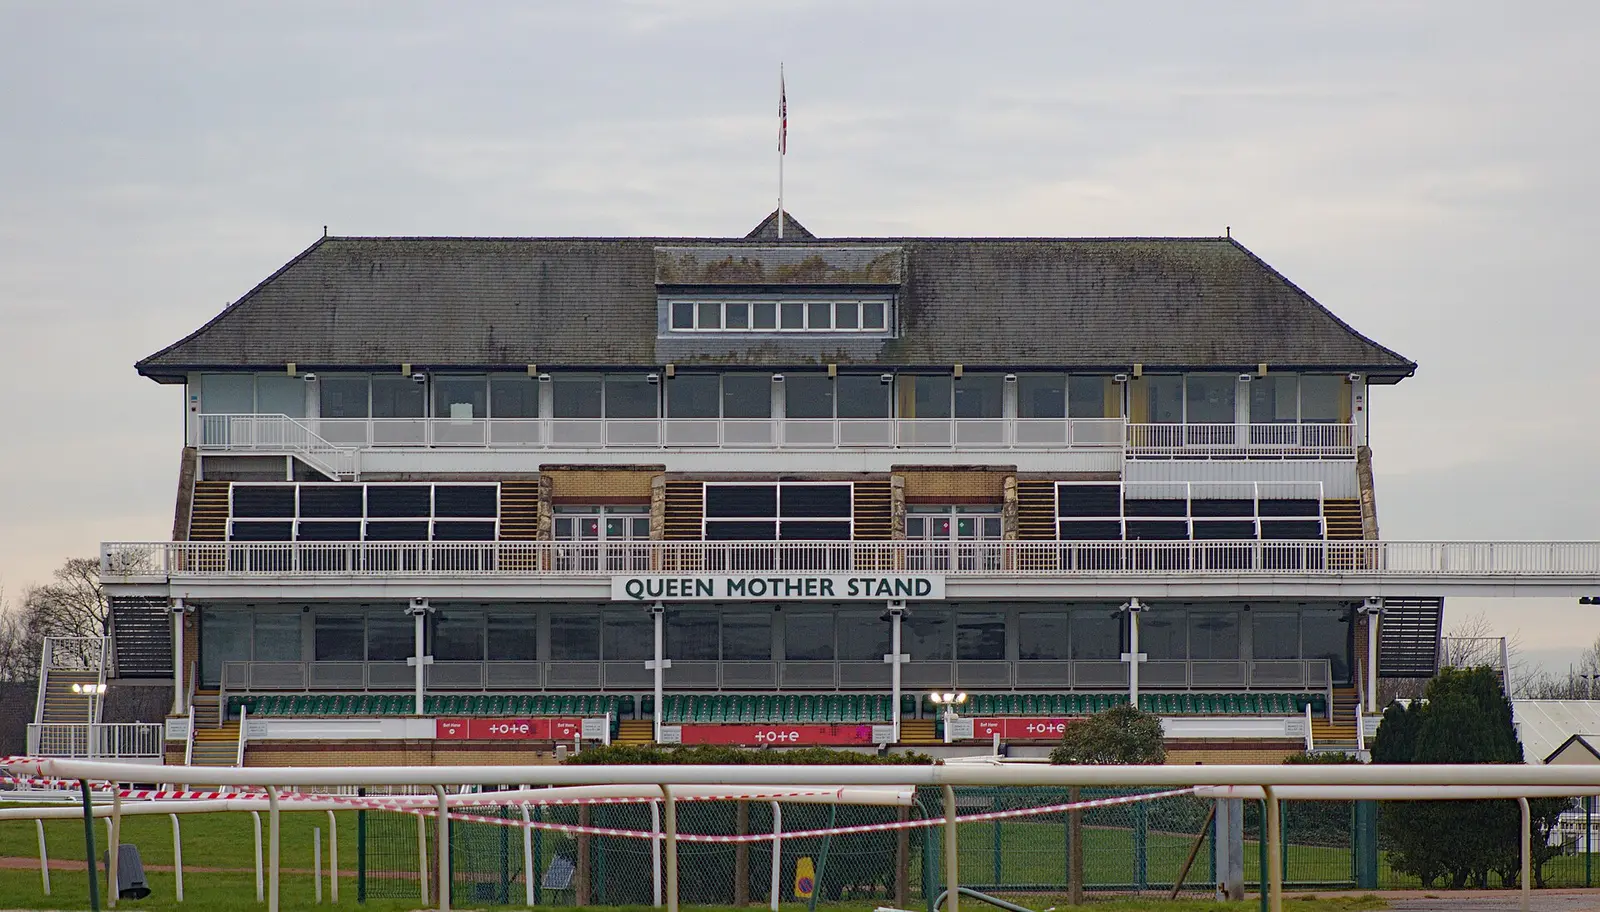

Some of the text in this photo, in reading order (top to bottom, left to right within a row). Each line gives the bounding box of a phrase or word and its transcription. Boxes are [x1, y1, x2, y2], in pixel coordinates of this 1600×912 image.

[625, 578, 932, 600] QUEEN MOTHER STAND
